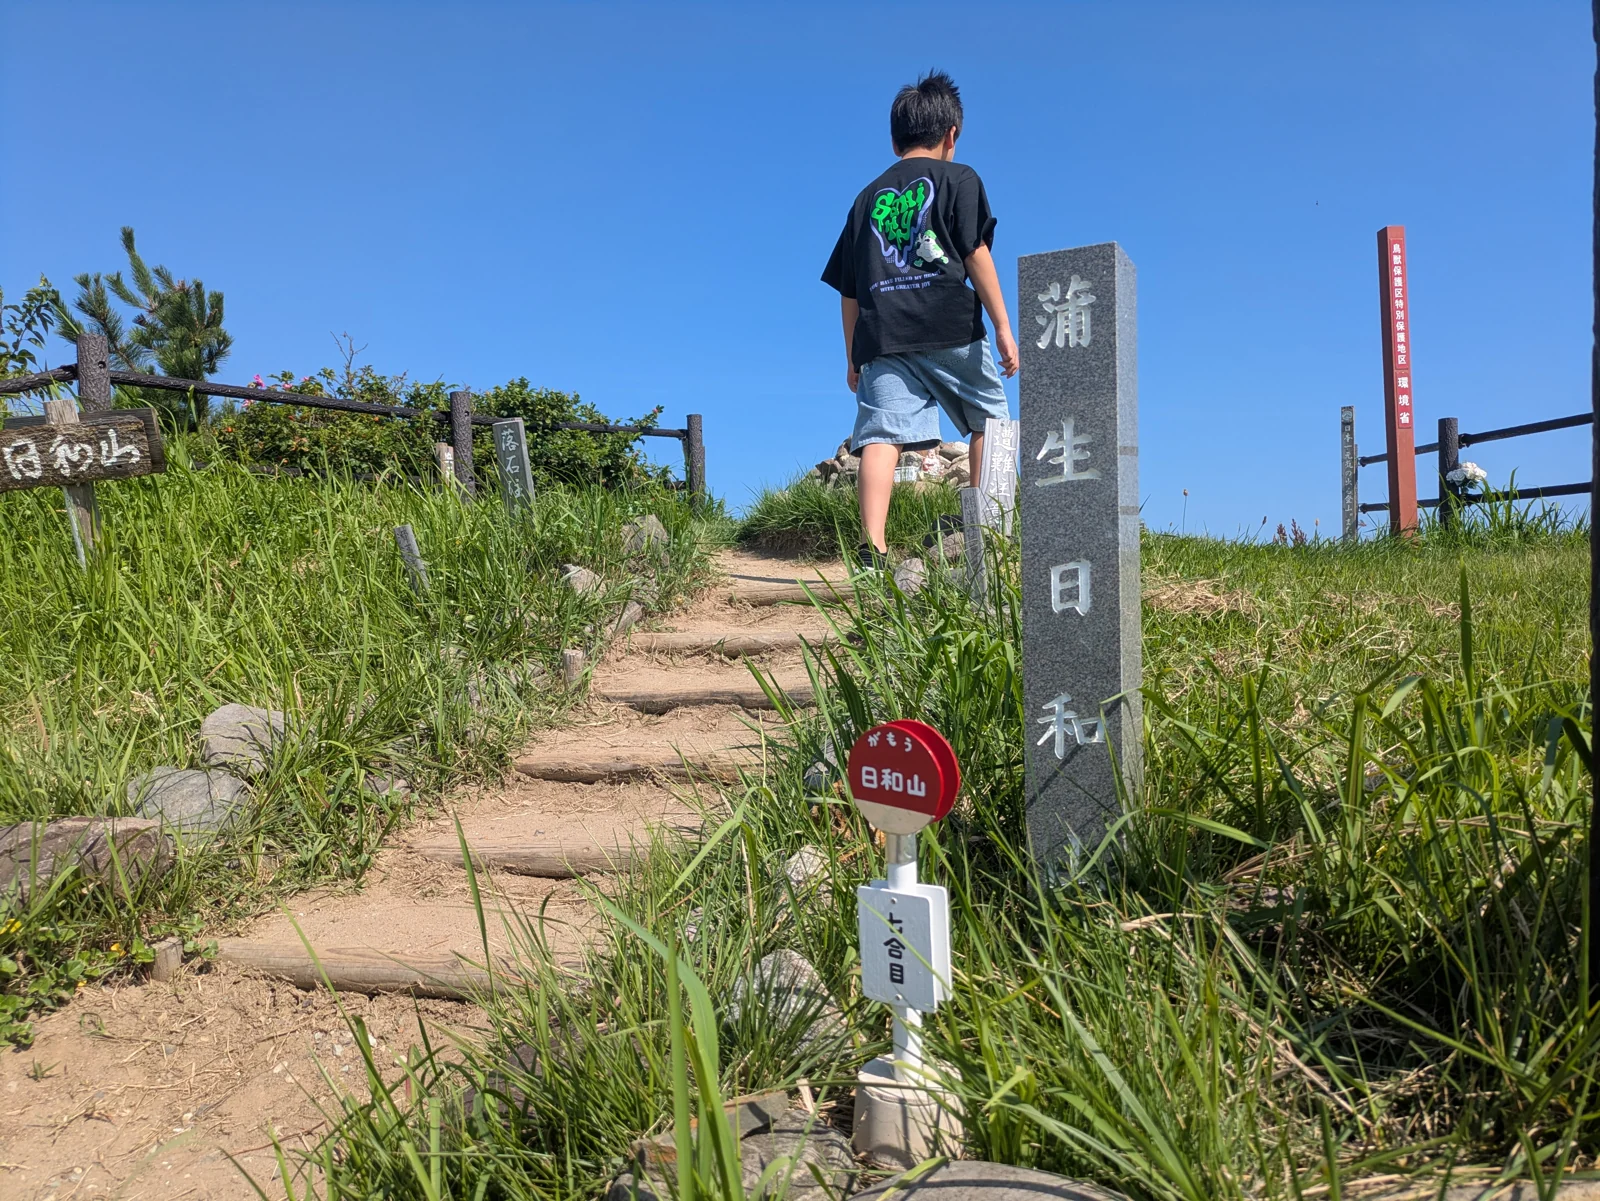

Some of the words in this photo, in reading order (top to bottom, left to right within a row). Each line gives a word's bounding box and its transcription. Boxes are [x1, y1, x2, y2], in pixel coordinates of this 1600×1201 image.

[1392, 243, 1407, 365] 鳥獣保護区特別保護地区
[1397, 376, 1411, 424] 環境省
[2, 428, 141, 481] 日和山
[501, 426, 523, 520] 落石注
[867, 731, 912, 752] がもう
[861, 766, 926, 797] 日和山
[883, 912, 906, 984] 七合目
